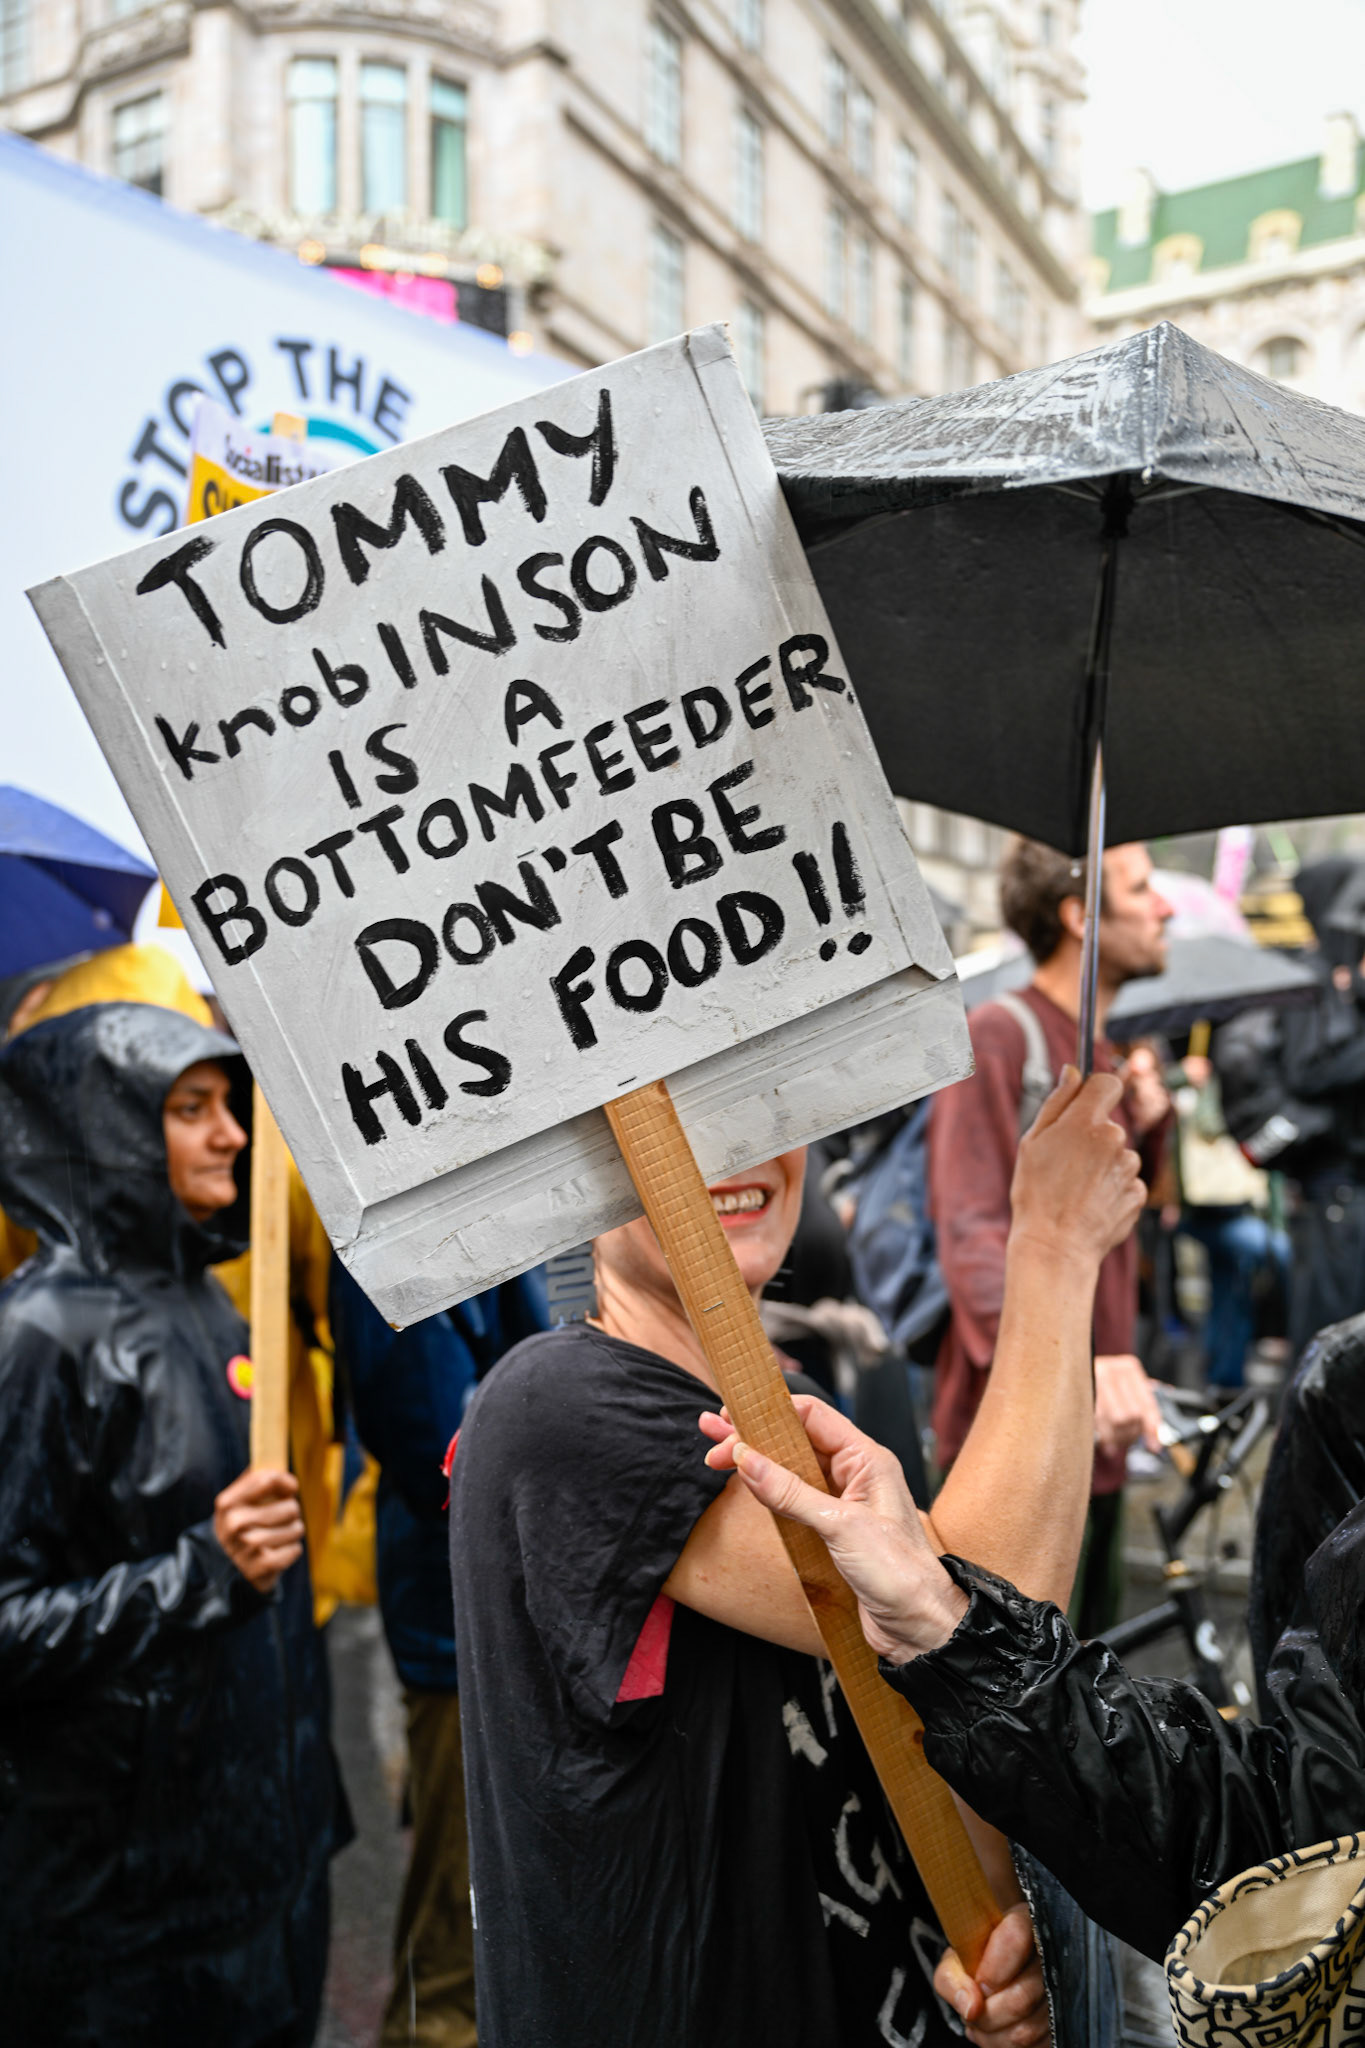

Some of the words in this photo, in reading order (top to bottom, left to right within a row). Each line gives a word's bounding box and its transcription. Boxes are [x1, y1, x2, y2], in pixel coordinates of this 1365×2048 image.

[277, 339, 410, 443] THE
[137, 388, 618, 649] TOMMY
[154, 486, 721, 781] knobINSON
[328, 723, 419, 809] IS
[504, 679, 563, 747] A
[354, 819, 628, 1010] DON'T
[651, 760, 786, 890] BE
[341, 1009, 512, 1146] HIS
